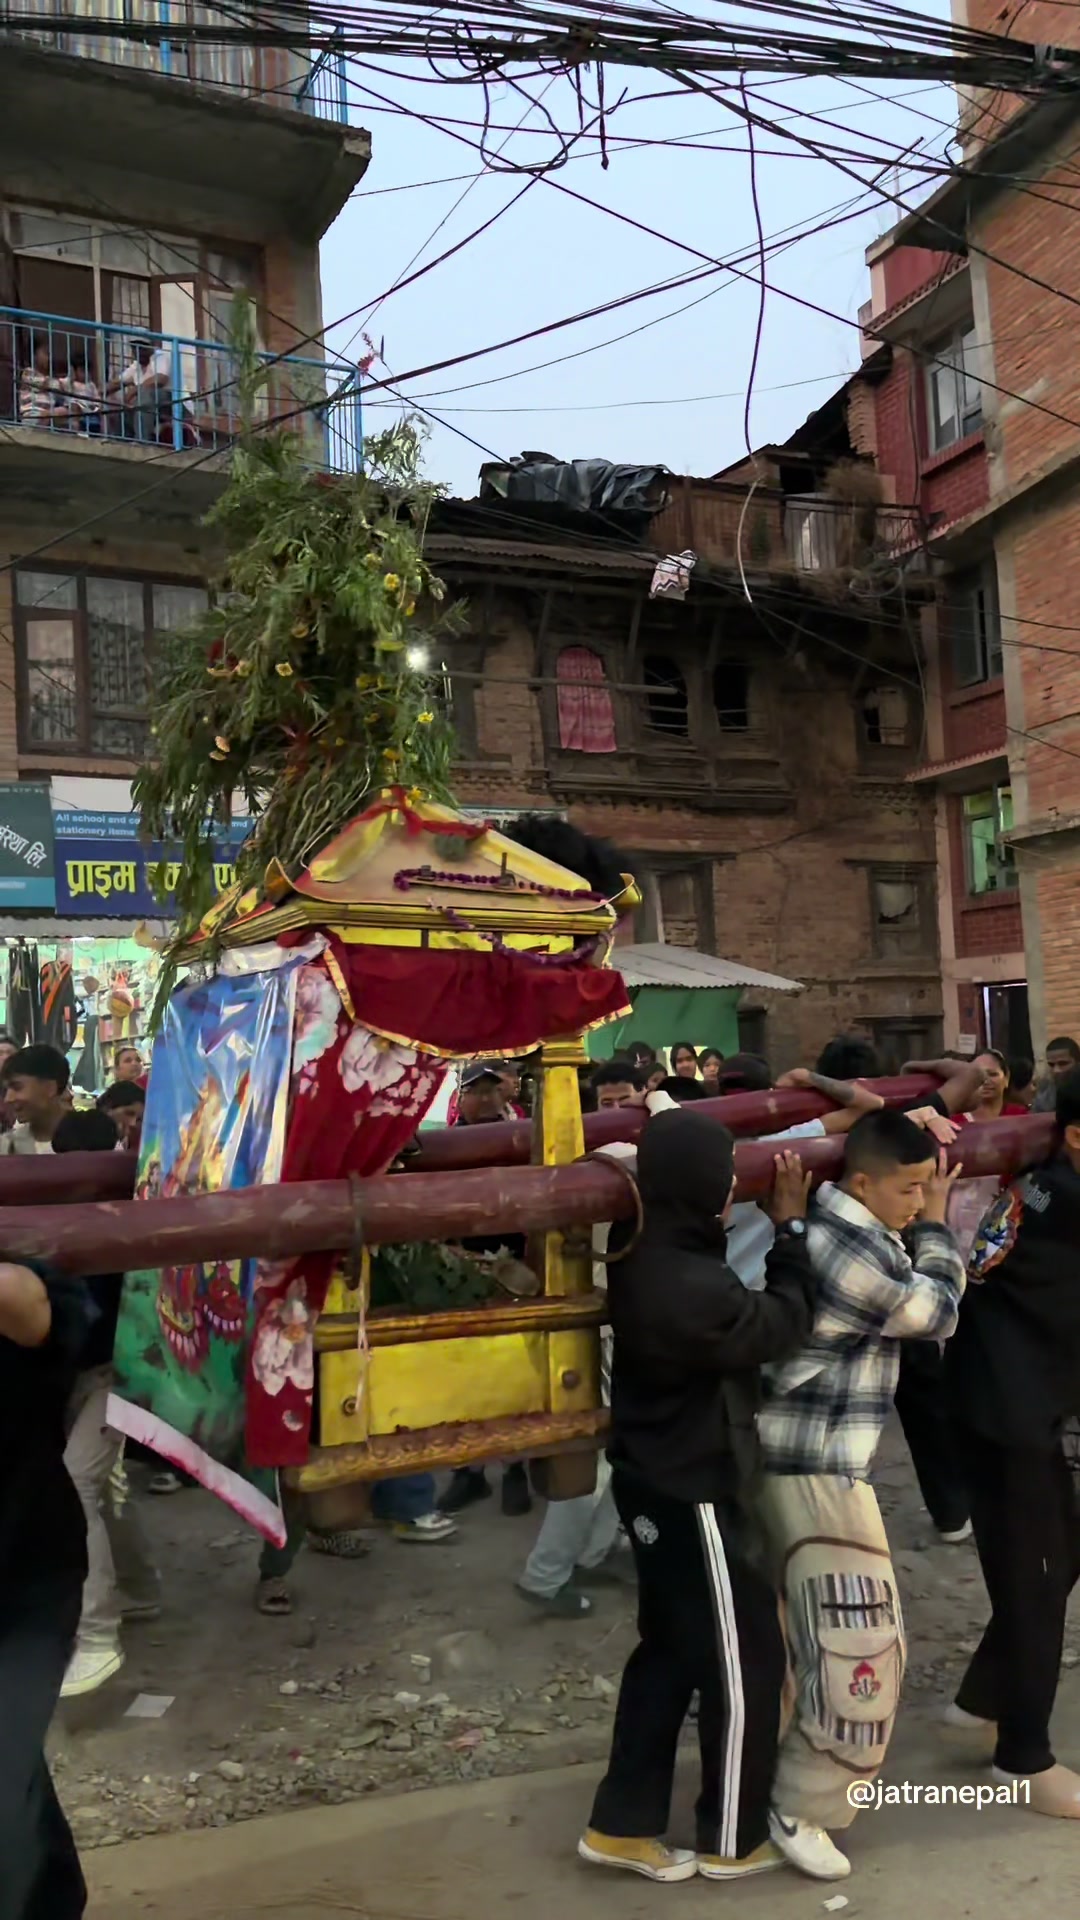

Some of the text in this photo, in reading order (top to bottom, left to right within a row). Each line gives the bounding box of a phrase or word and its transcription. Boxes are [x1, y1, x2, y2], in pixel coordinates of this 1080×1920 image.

[56, 813, 70, 822] All
[72, 814, 106, 823] school
[65, 860, 137, 899] प्राइम
